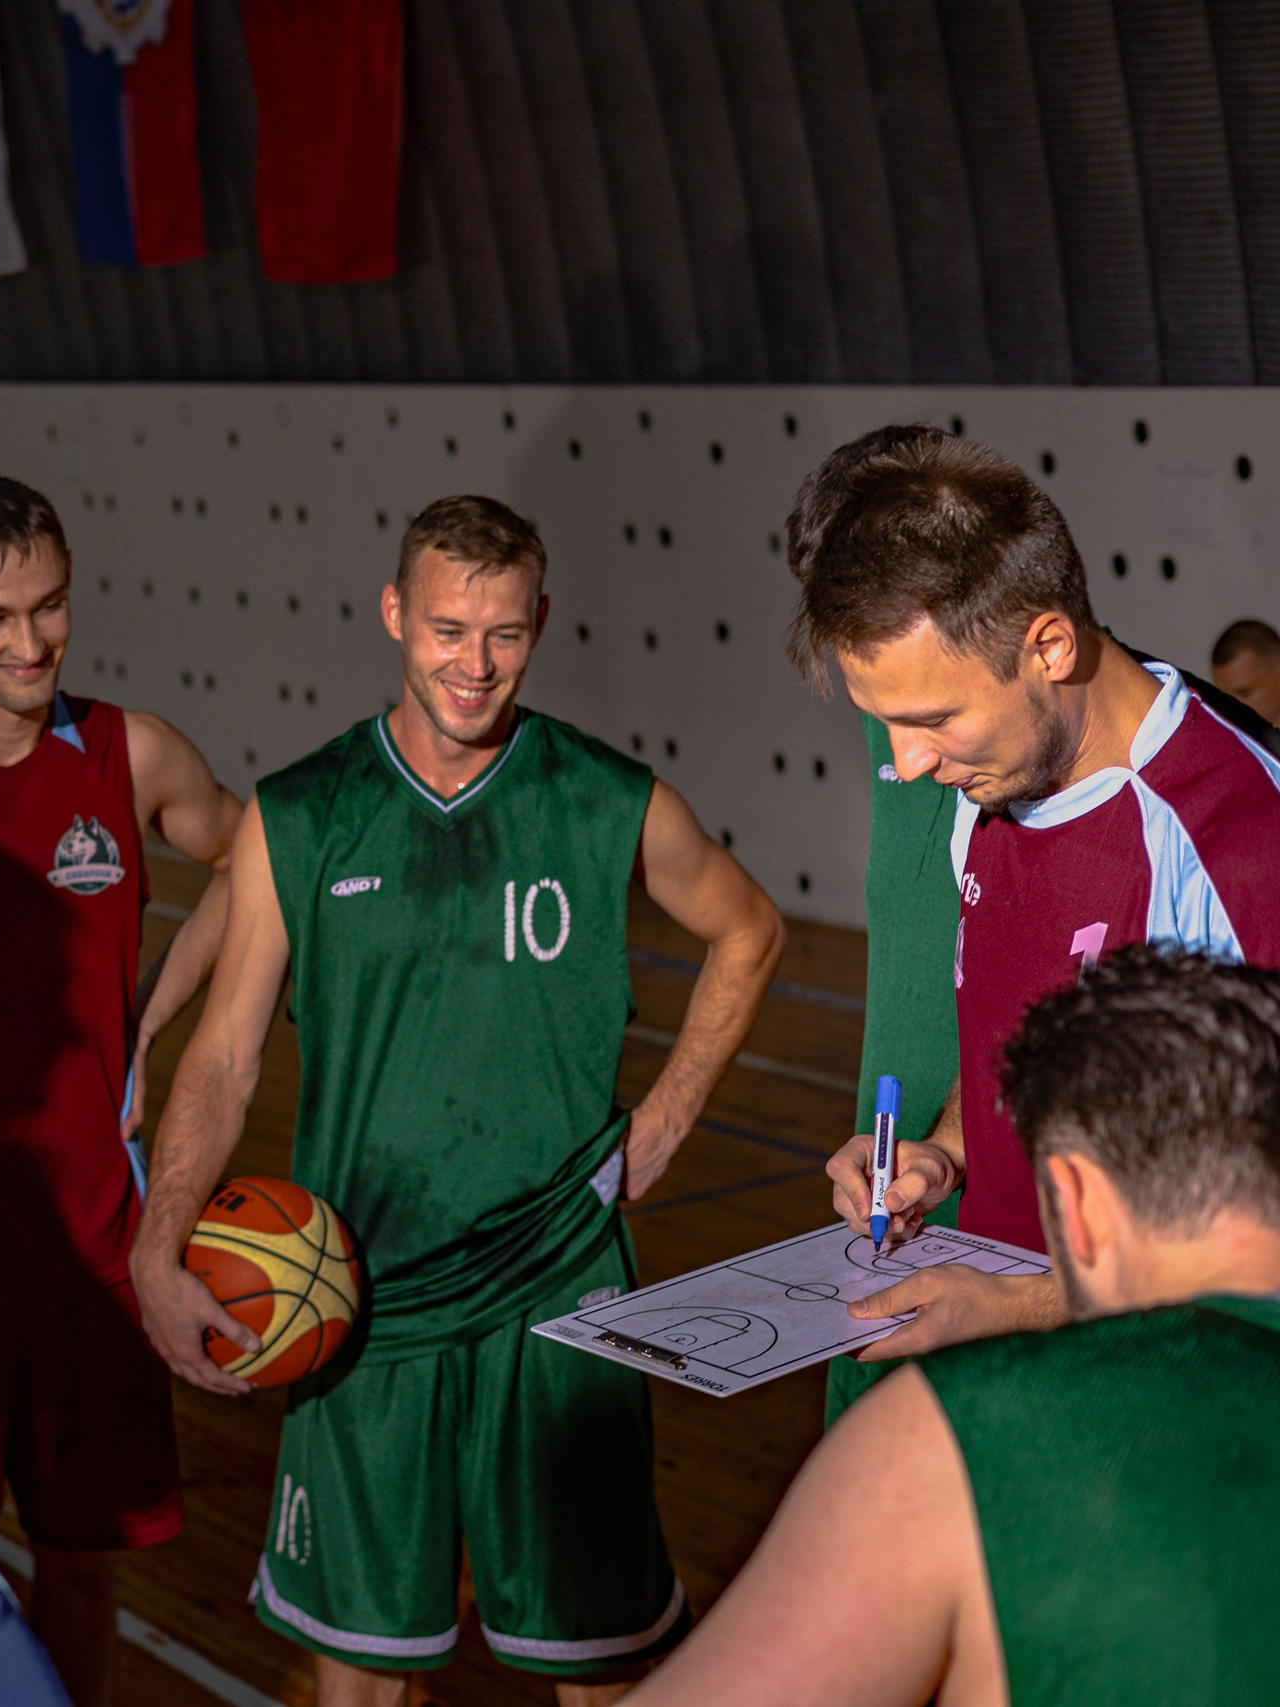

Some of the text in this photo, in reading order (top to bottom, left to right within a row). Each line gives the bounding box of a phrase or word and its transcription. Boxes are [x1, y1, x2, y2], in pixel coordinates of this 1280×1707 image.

[331, 876, 382, 897] AND1
[960, 872, 982, 907] rte
[504, 877, 571, 962] 10
[682, 1373, 729, 1391] TORRES
[275, 1473, 311, 1566] 10
